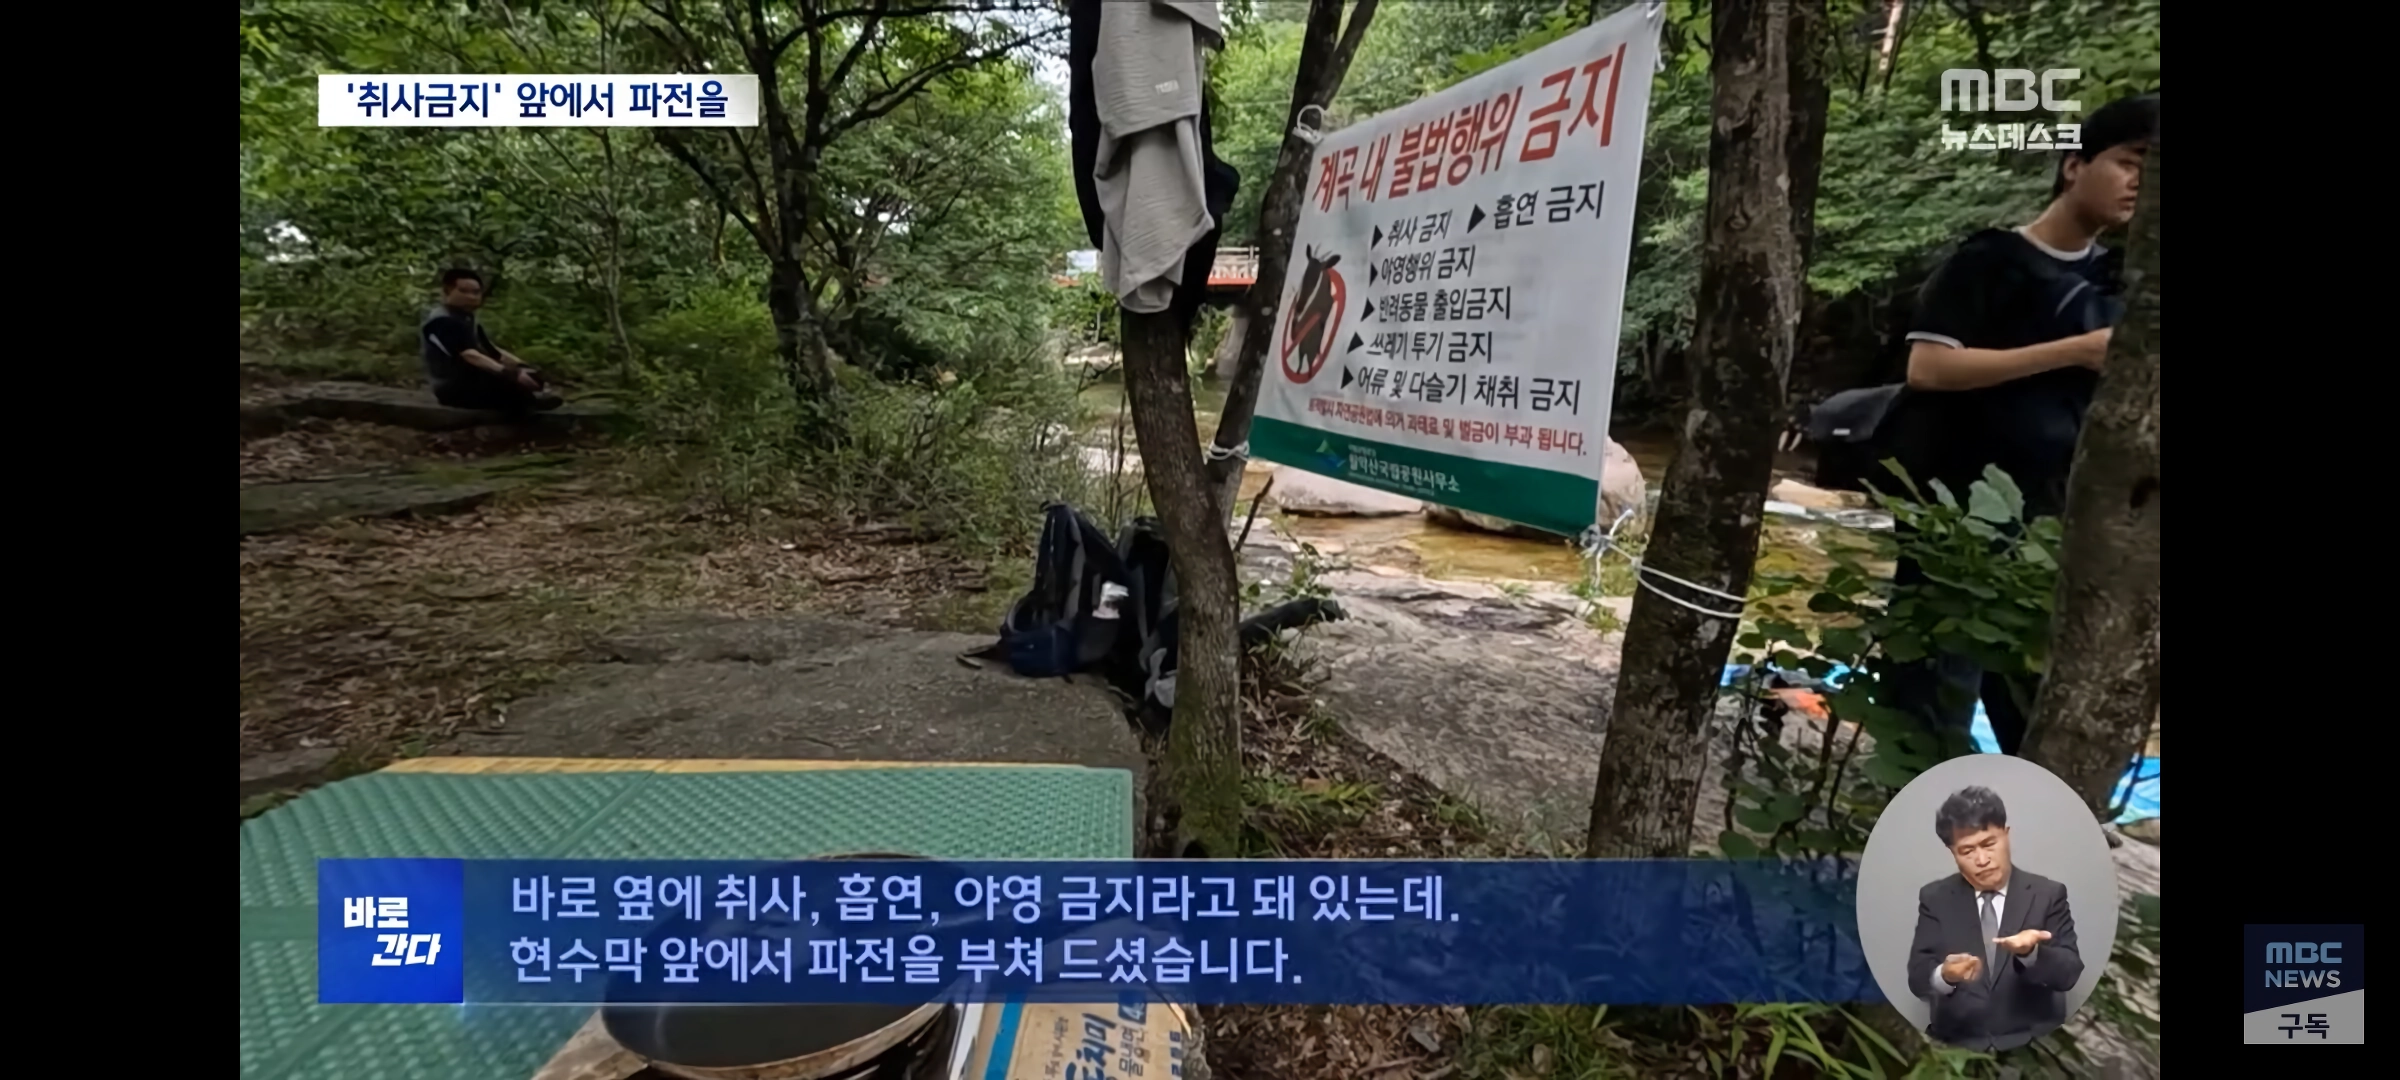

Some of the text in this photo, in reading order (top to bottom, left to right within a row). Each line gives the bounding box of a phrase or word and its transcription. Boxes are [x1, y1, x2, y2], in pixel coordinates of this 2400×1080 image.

[1312, 42, 1627, 213] 계곡 내 불법행위 금지
[1494, 180, 1604, 230] 흡연 금지
[1387, 209, 1453, 247] 취사 금지
[1381, 245, 1476, 285] 야영행위 금지
[1379, 286, 1511, 323] 반려동물 출입금지
[1366, 331, 1492, 364] 쓰레기 투기 금지
[1357, 365, 1581, 415] 어류 및 다슬기 채취 금지
[1407, 414, 1440, 436] 과태료
[1459, 419, 1499, 445] 벌금이
[1504, 423, 1533, 449] 부과
[1537, 427, 1587, 457] 됩니다.
[1118, 1024, 1145, 1077] 물냉면
